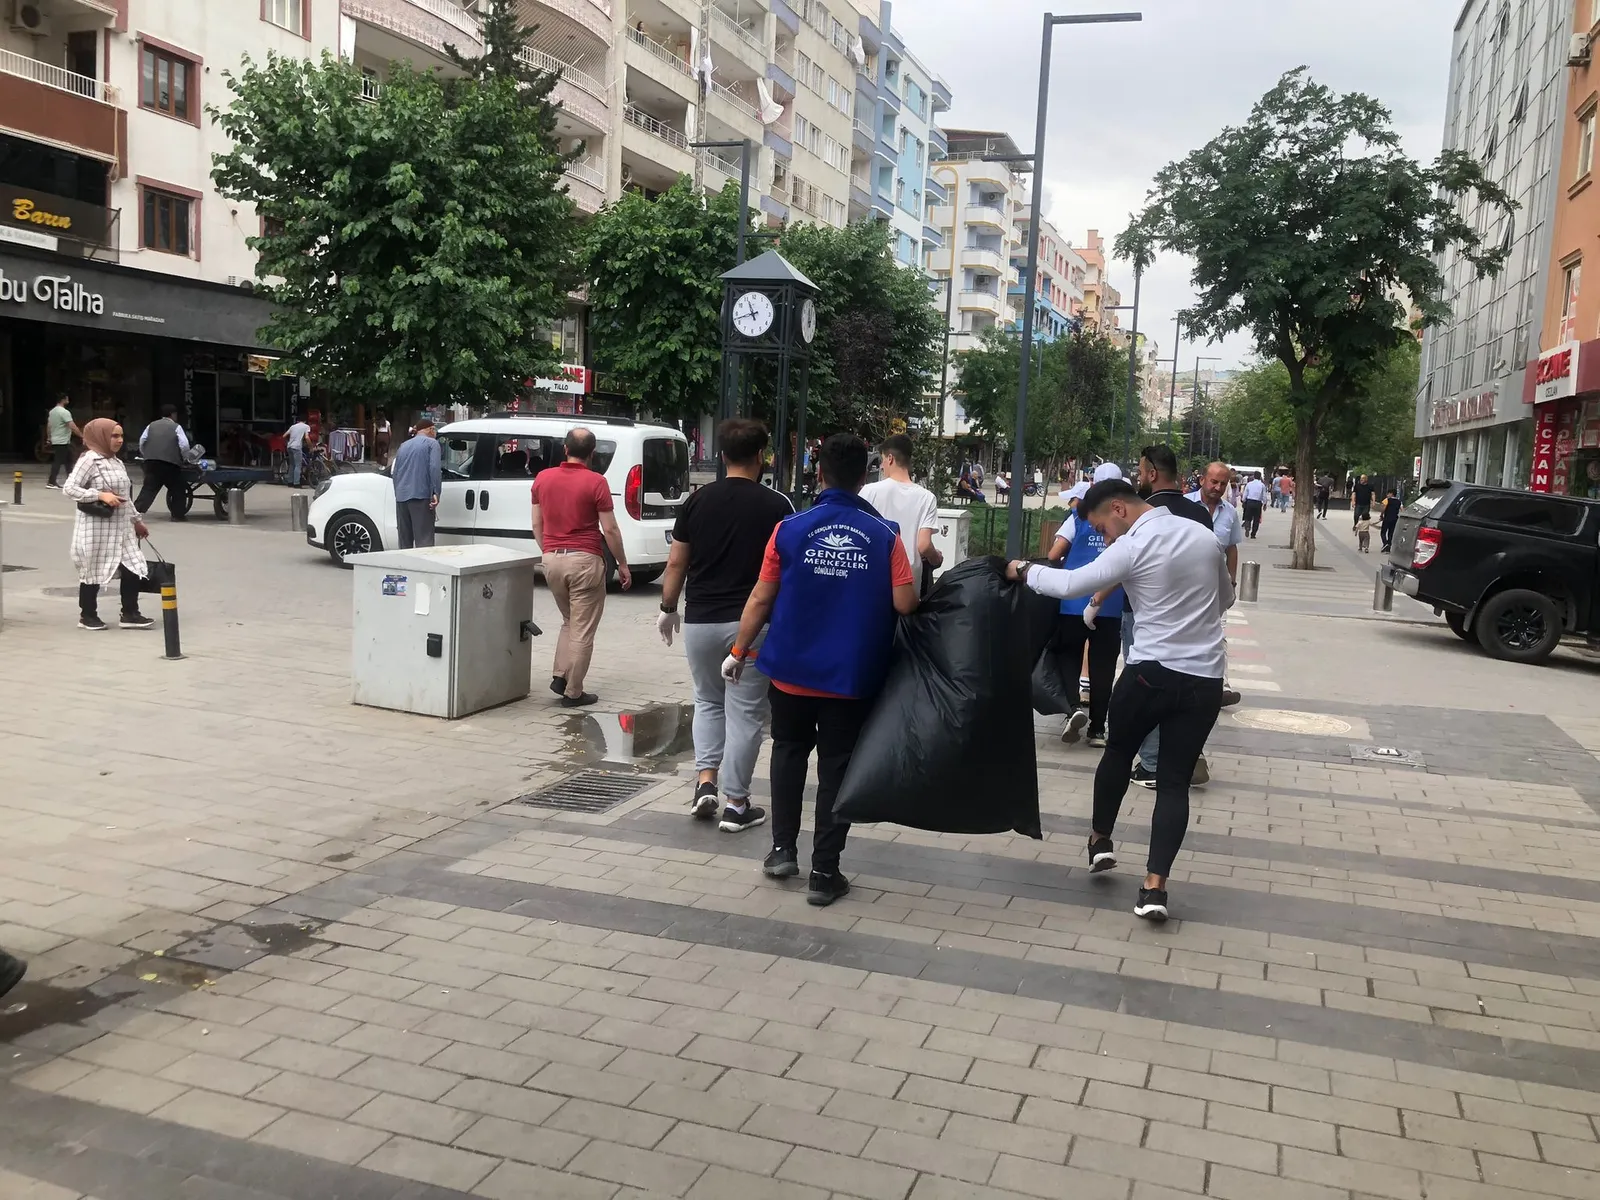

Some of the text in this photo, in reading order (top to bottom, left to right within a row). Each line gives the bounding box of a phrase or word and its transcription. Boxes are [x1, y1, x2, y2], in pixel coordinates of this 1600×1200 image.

[33, 275, 104, 315] Talha
[1536, 413, 1553, 493] ECZAN
[805, 548, 868, 563] GENÇLİK
[835, 568, 849, 579] GENÇ
